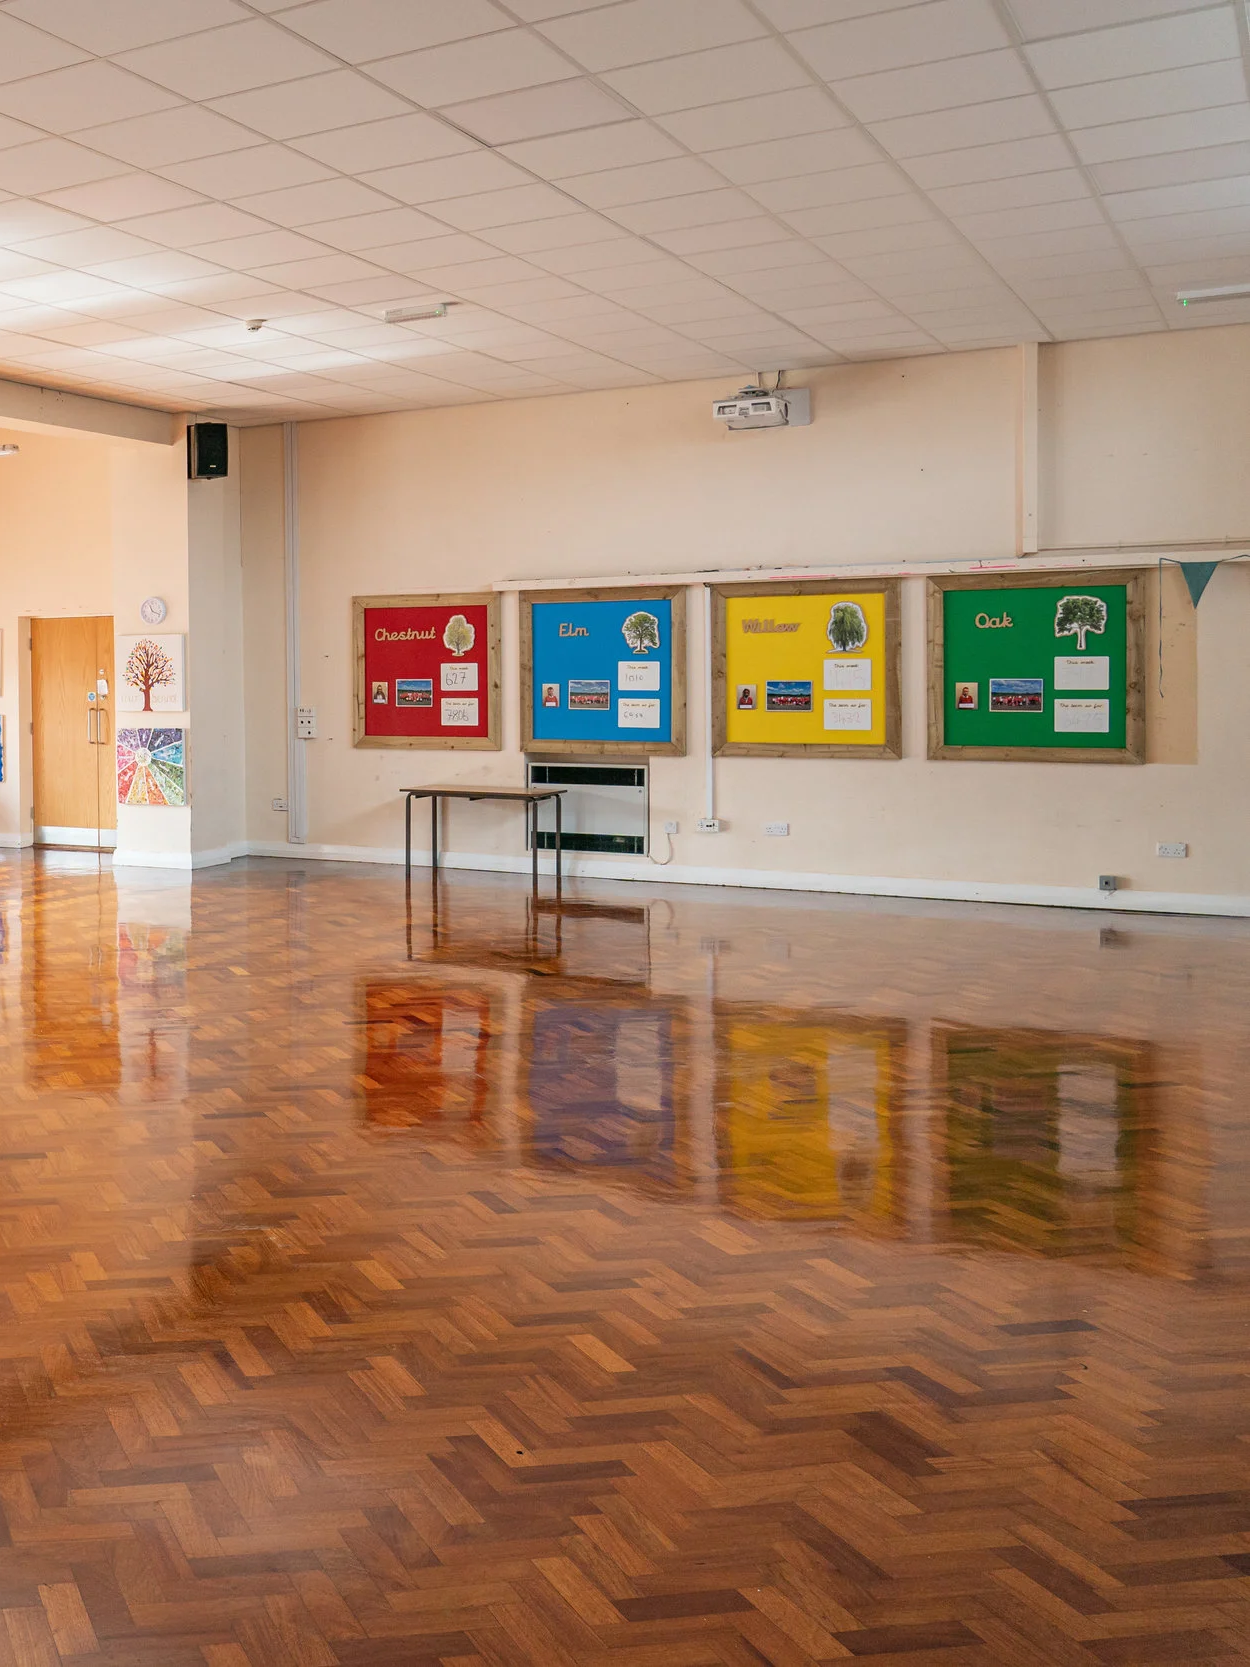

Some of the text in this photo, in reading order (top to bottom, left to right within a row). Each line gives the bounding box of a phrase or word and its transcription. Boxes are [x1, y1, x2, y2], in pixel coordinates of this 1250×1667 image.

[742, 618, 802, 634] Willow
[975, 612, 1014, 629] Oak
[375, 626, 436, 641] Chestnut
[559, 622, 590, 637] Elm
[445, 671, 466, 686] 627
